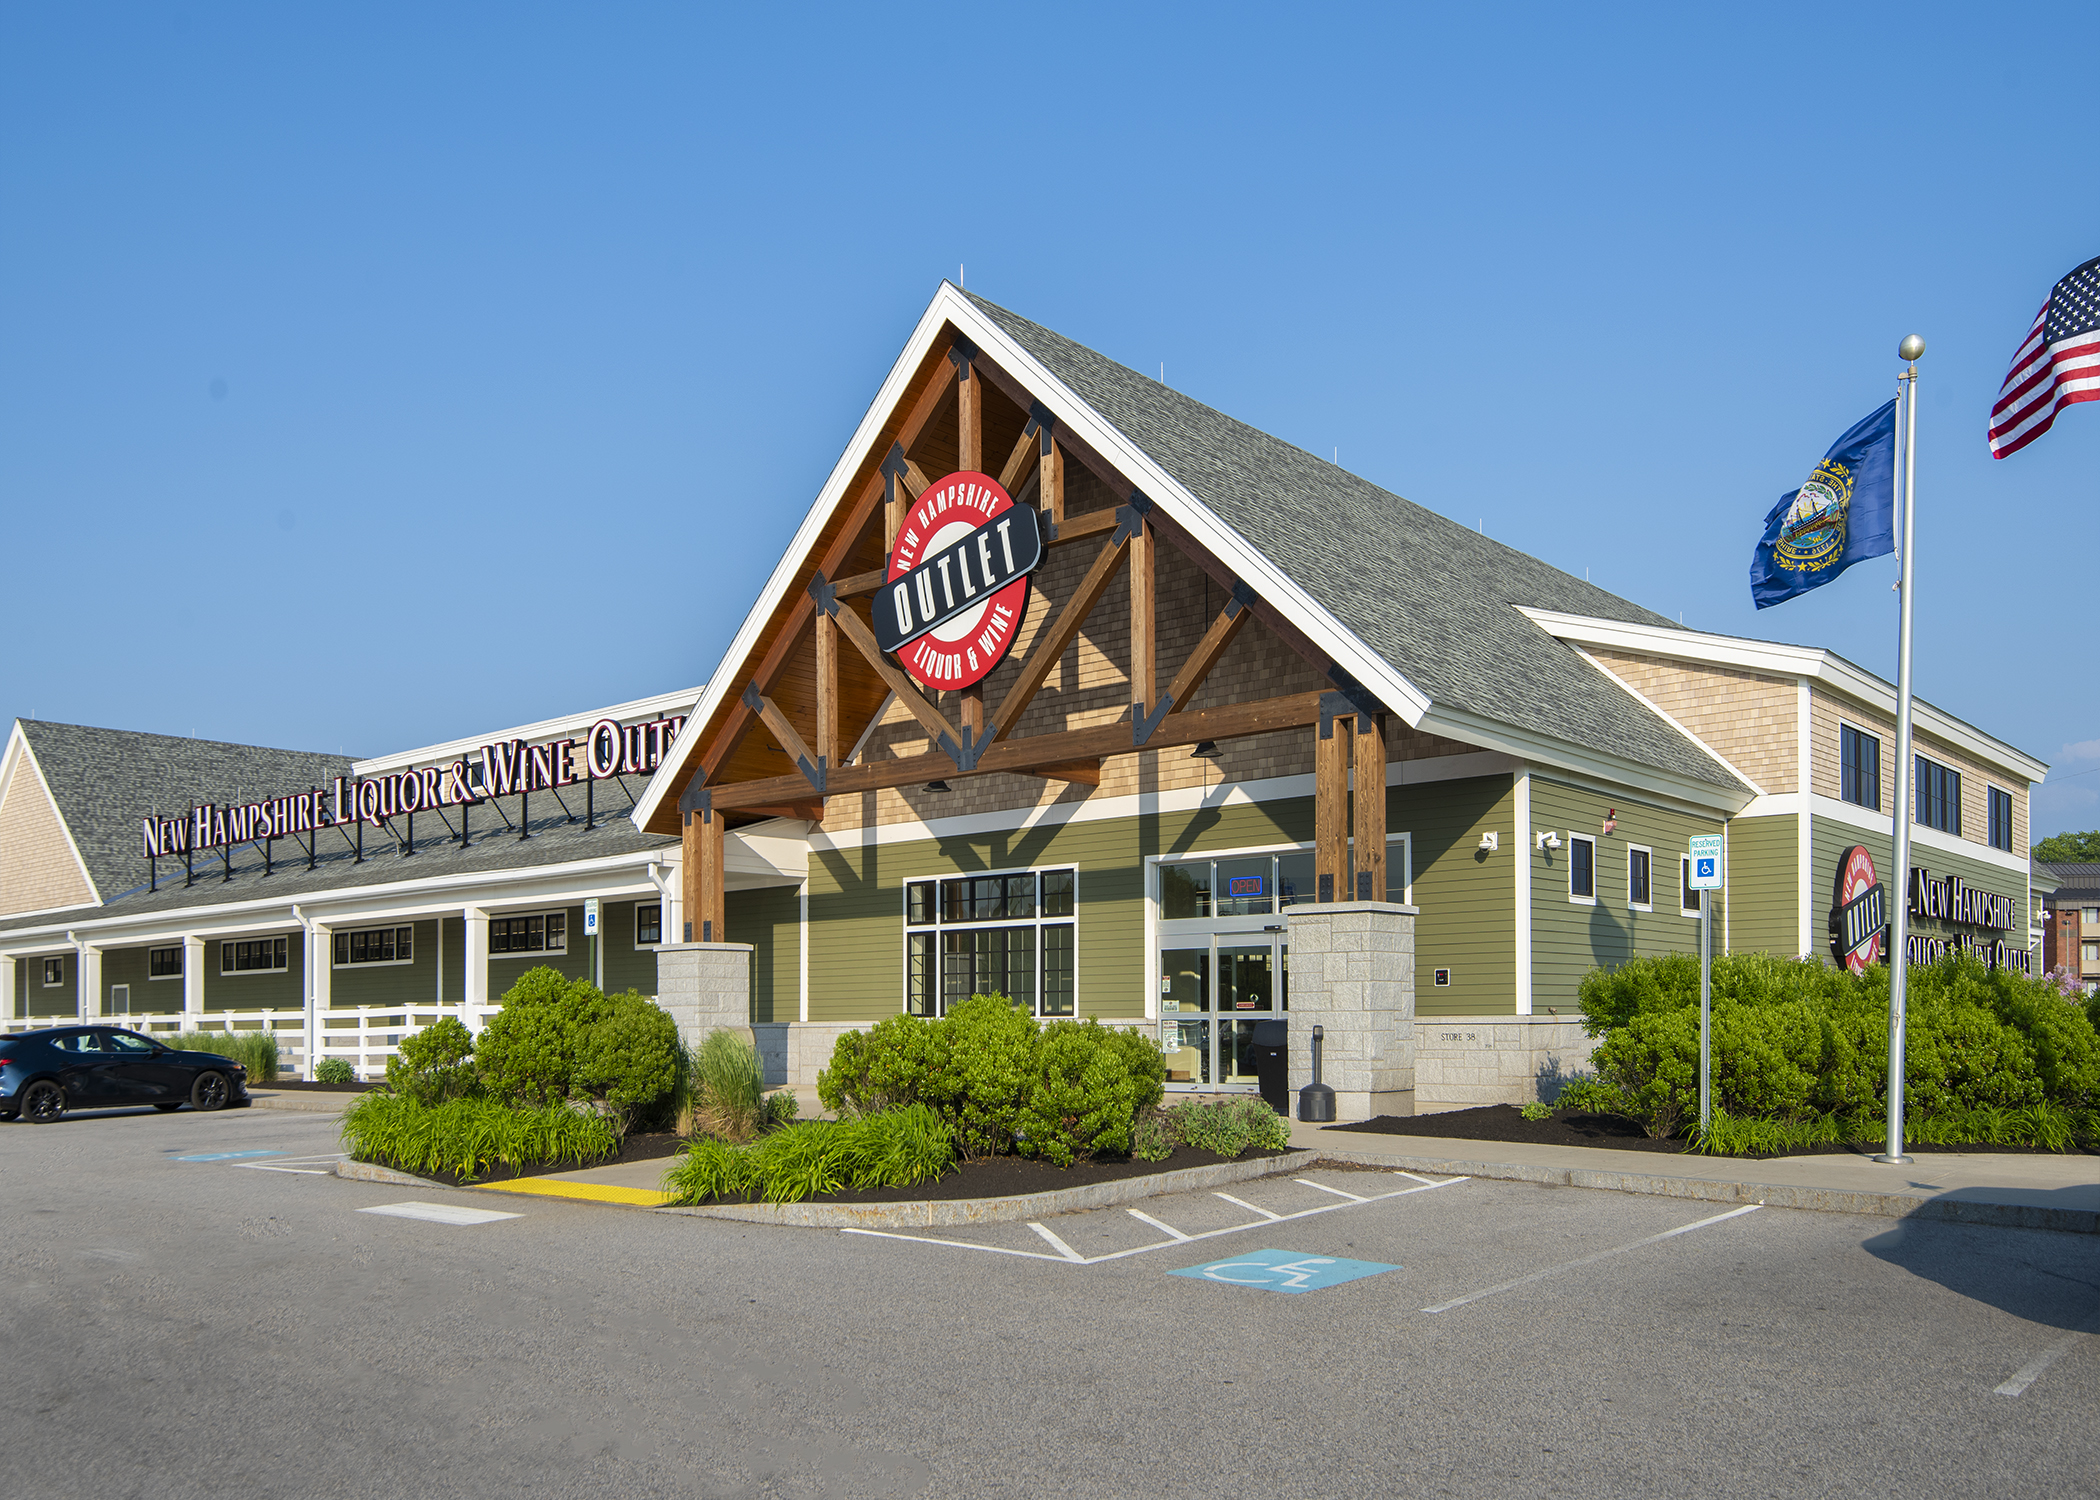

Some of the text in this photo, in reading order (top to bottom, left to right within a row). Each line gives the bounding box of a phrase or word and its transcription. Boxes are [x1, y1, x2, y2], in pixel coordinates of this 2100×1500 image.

[897, 483, 999, 571] NEW HAMPSHIRE
[893, 518, 1015, 636] OUTLET
[913, 602, 1013, 681] LIQUOR & WINE
[143, 716, 685, 859] NEW HAMPSHIRE LIQUOR & WINE OUT
[1692, 839, 1720, 848] RESERVED
[1693, 848, 1719, 857] PARKING
[1231, 879, 1260, 893] OPEN
[1844, 871, 1853, 902] NEW
[1918, 867, 2016, 931] NEW HAMPSHIRE
[1847, 890, 1881, 947] OUTLET
[1441, 1033, 1476, 1041] STORE 38
